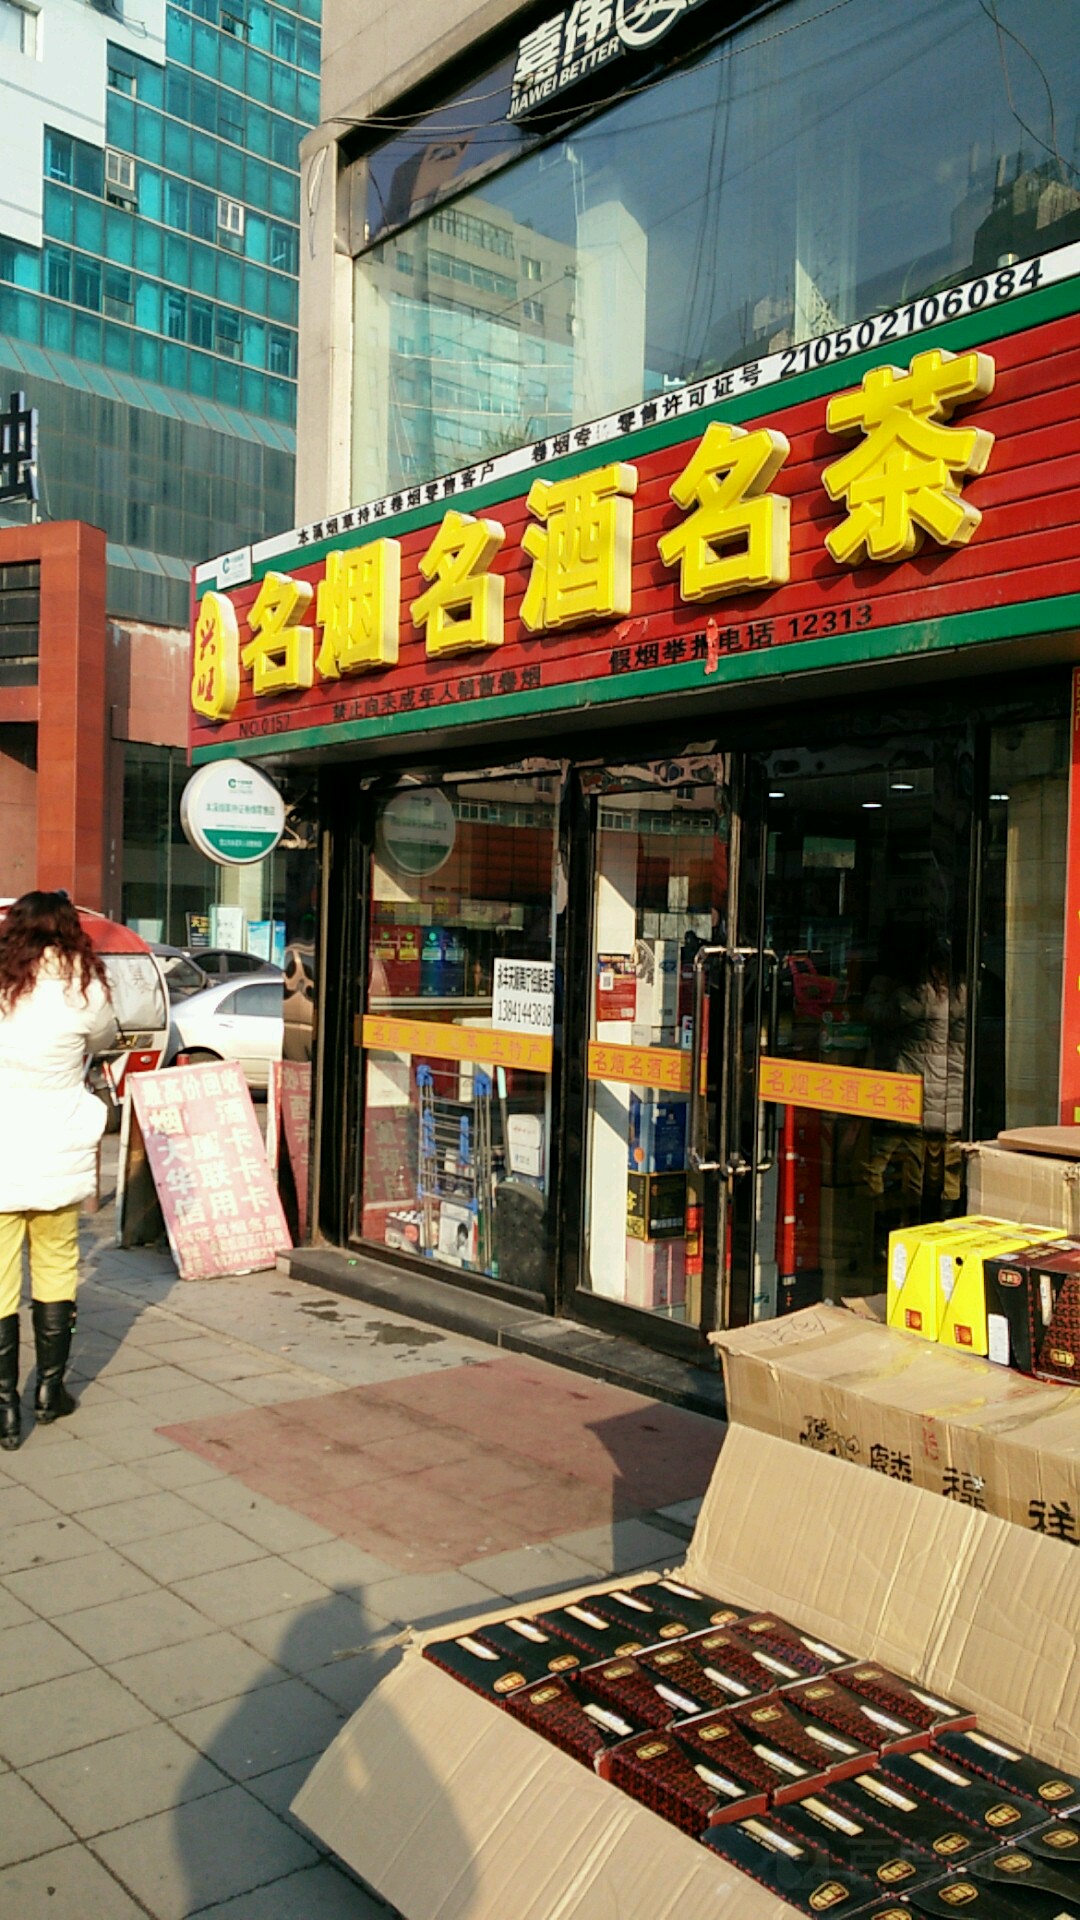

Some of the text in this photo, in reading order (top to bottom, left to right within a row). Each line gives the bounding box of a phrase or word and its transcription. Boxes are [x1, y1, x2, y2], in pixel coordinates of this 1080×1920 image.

[506, 35, 621, 120] JIAWEI BETTER
[780, 258, 1043, 378] 210502106084
[242, 349, 996, 697] 名烟名酒名茶
[788, 603, 873, 637] 12313
[592, 1050, 692, 1082] 名烟名酒名
[766, 1068, 916, 1111] 名烟名酒名茶
